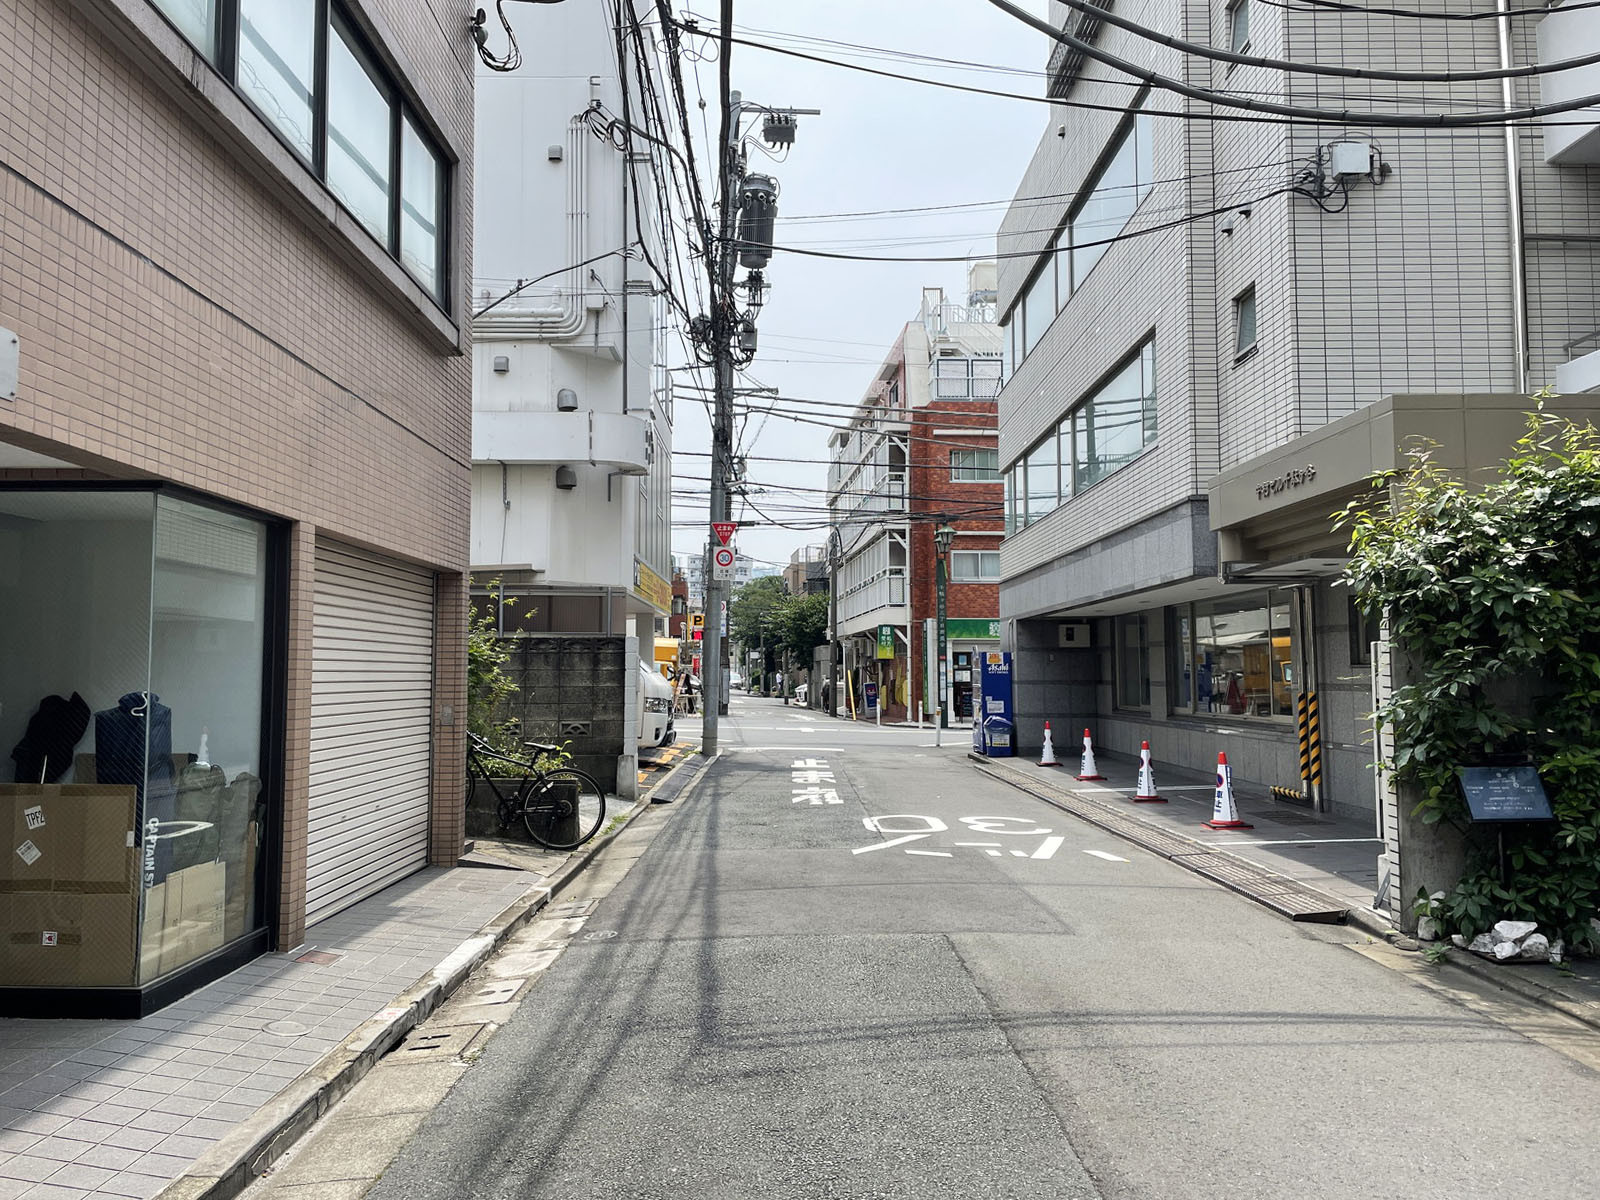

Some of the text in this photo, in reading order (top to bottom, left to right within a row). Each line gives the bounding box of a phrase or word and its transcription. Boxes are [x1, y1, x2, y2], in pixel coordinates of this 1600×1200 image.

[719, 553, 730, 563] 30
[694, 615, 703, 626] P
[987, 663, 1009, 672] Asahi
[791, 759, 844, 805] 止まれ
[25, 811, 45, 827] TPF2
[145, 817, 160, 871] CAPTAIN
